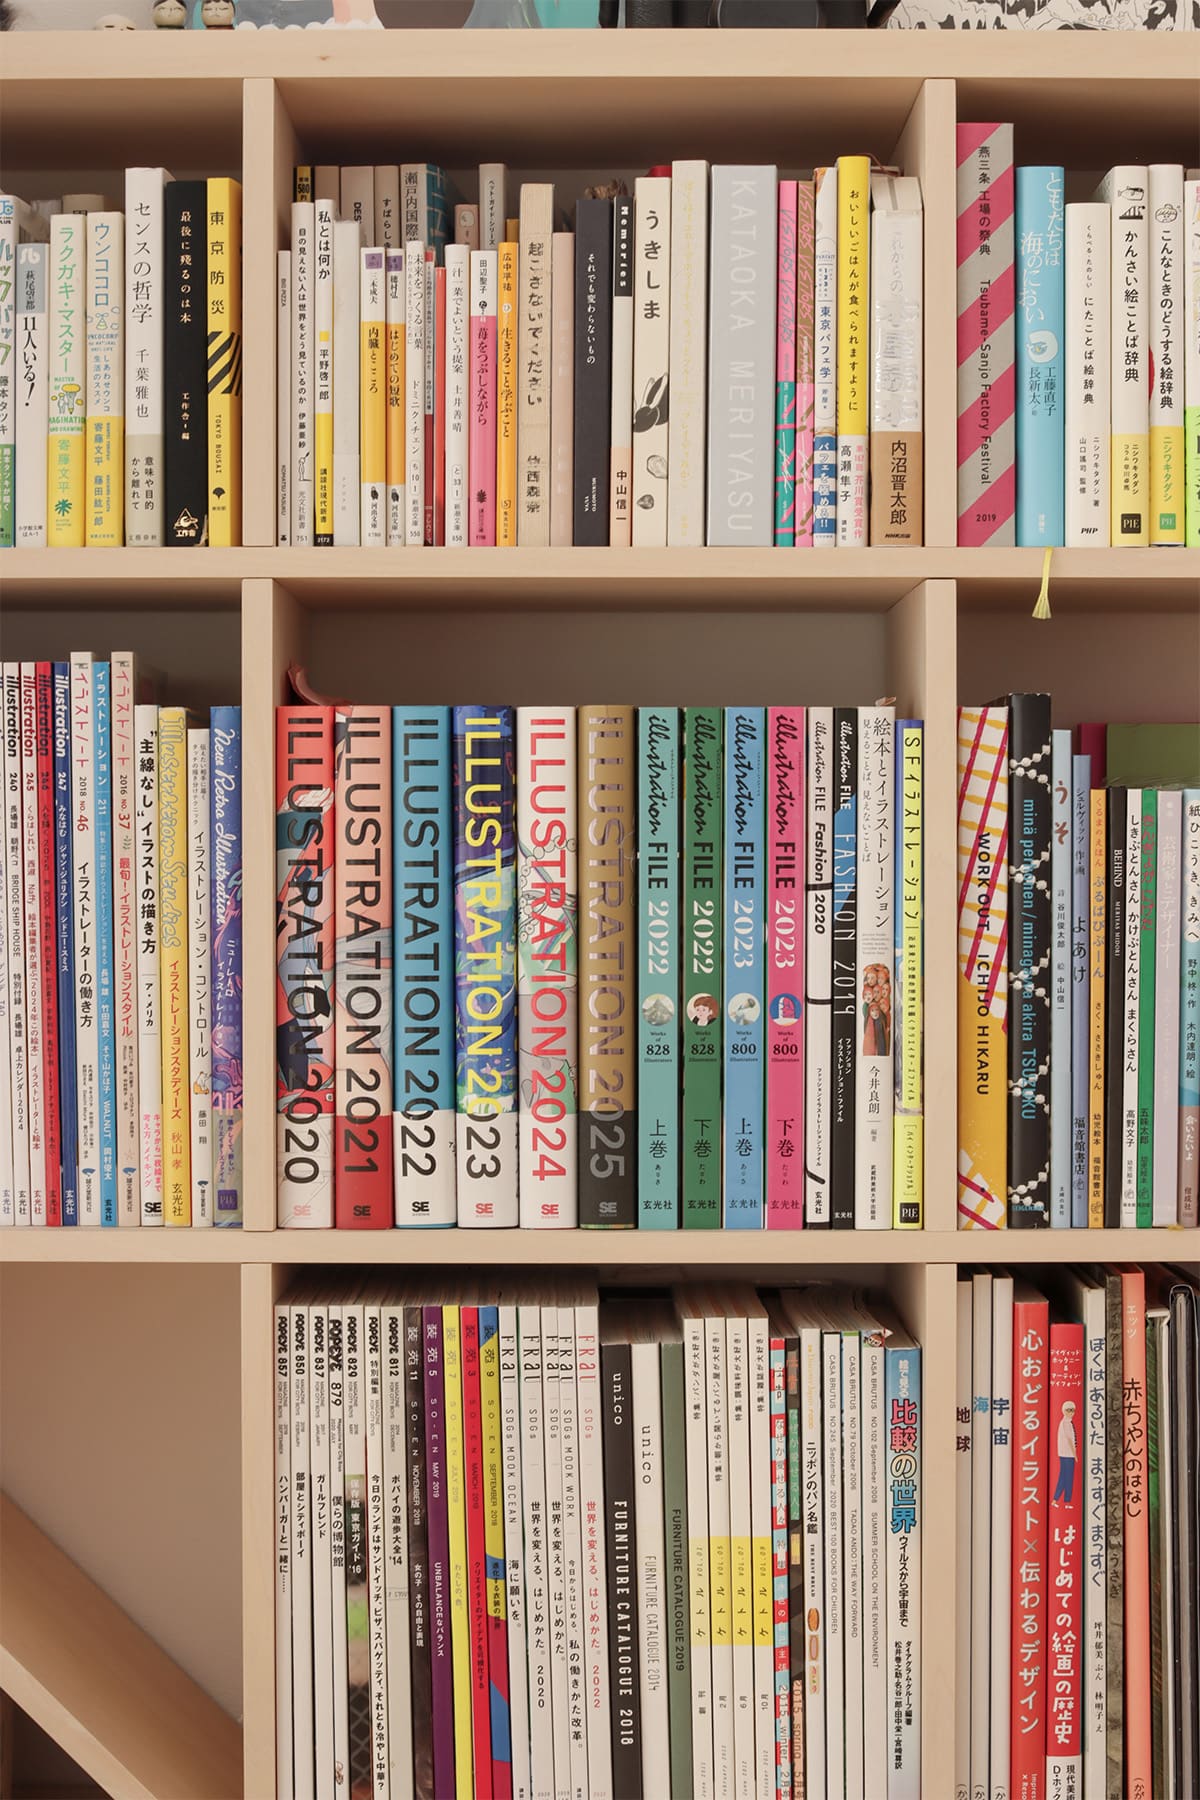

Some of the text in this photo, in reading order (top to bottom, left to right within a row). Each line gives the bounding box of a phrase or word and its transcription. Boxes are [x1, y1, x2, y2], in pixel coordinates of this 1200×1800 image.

[978, 145, 991, 256] 燕三条 工場の祭典
[1045, 172, 1064, 266] ともだちは
[57, 226, 76, 373] ラクガキ・マスター
[94, 223, 111, 307] ウンココロ
[133, 202, 153, 324] センスの哲学
[180, 210, 192, 323] 最後に残るのは本
[210, 210, 225, 315] 東京防災
[318, 210, 331, 401] 私とは何か 平野啓一郎
[413, 254, 425, 351] 未来をつくる言葉
[643, 210, 662, 320] うきしま
[848, 190, 860, 411] おいしいごはんが食べられますように
[1019, 232, 1045, 324] 海のにおい
[1124, 230, 1139, 382] かんさい絵ことば辞典
[298, 228, 307, 404] 目の見えない人は世界をどう見ているのか
[368, 326, 380, 394] 内臓とこころ
[389, 330, 400, 407] はじめての短歌
[452, 260, 464, 433] 一汁一菜でよいという提案 土井善晴
[477, 260, 489, 426] 田辺聖子 苺をつぶしながら
[527, 242, 544, 406] 起こさないでください
[727, 180, 758, 531] KATAOKA MERIYASU
[819, 306, 831, 378] 東京パフェ学
[1083, 297, 1095, 404] にたことば絵辞典
[1160, 229, 1174, 409] こんなときのどうする絵辞典
[136, 349, 150, 418] 千葉雅也
[500, 328, 513, 438] 生きること学ぶこと
[978, 279, 992, 484] Tsubame-Sanjo Factory Festival
[1044, 366, 1057, 417] 工藤直子
[144, 456, 155, 511] 意味や目的
[615, 470, 628, 521] 中山信一
[840, 445, 852, 502] 高瀬隼子
[890, 440, 908, 526] 内沼晋太郎
[976, 514, 997, 522] 2019
[1092, 437, 1100, 495] ニシワキタダシ
[1081, 527, 1098, 535] PHP
[1123, 517, 1140, 529] PIE
[6, 675, 20, 758] illustration
[22, 675, 36, 758] illustration
[38, 674, 51, 757] illustration
[55, 674, 69, 758] illustration
[96, 670, 108, 786] イラストレーション
[160, 716, 187, 949] Illustration Studies
[214, 728, 238, 925] New Retro Illustration
[647, 713, 670, 975] illustration FILE 2022
[693, 713, 717, 975] illustration FILE 2022
[734, 713, 757, 969] illustration FILE 2023
[775, 713, 798, 969] illustration FILE 2023
[814, 720, 827, 935] illustration FILE Fashion 2020
[874, 717, 892, 929] 絵本とイラストレーション
[904, 736, 921, 920] SFイラストレーション
[1023, 798, 1037, 835] minä
[1054, 780, 1070, 845] うそ
[833, 720, 857, 1016] illustration FILE FASHION 2019
[1020, 839, 1038, 908] perhonen
[1113, 849, 1123, 888] BEHIND
[77, 862, 93, 1028] イラストレーターの働き方
[284, 716, 324, 1184] ILLUSTRATION 2020
[344, 716, 382, 1173] ILLUSTRATION 2021
[401, 717, 440, 1177] ILLUSTRATION 2022
[464, 717, 503, 1179] ILLUSTRATION 2023
[530, 717, 568, 1182] ILLUSTRATION 2024
[588, 716, 626, 1178] ILLUSTRATION 2025
[976, 832, 991, 1095] WORK OUT ICHIJO HIKARU
[1072, 915, 1087, 984] よあけ
[1126, 815, 1140, 1073] しきぶとんさん かけぶとんさん まくらさん
[169, 960, 183, 1120] イラストレーションスタディーズ
[646, 1044, 671, 1055] 828
[690, 1044, 715, 1055] 828
[731, 1044, 757, 1055] 800
[772, 1044, 798, 1055] 800
[1022, 1004, 1037, 1041] akira
[649, 1117, 668, 1159] 上巻
[693, 1118, 712, 1159] 下巻
[867, 1065, 881, 1114] 今井良朗
[278, 1316, 288, 1378] POPEYE 857
[314, 1315, 325, 1378] POPEYE 837
[331, 1382, 342, 1407] 879
[347, 1316, 357, 1378] POPEYE 829
[388, 1316, 399, 1377] POPEYE 812
[956, 1406, 971, 1453] 地球
[973, 1396, 990, 1414] 海
[992, 1397, 1010, 1446] 宇宙
[1122, 1377, 1144, 1519] 赤ちゃんのはなし
[316, 1475, 327, 1539] ガールフレンド
[805, 1441, 820, 1535] ニッポンのパン名鑑
[890, 1398, 918, 1535] 比較の世界
[1089, 1337, 1106, 1588] ぼくは あるいた まっすぐ まっすぐ
[332, 1495, 344, 1568] 僕らの博物館
[612, 1373, 634, 1746] unico FURNITURE CATALOGUE 2018
[871, 1547, 879, 1581] SCHOOL
[1018, 1329, 1044, 1735] 心おどるイラスト×伝わるデザイン
[434, 1562, 445, 1658] UNBALANCEなバランス
[531, 1501, 546, 1709] 世界を変える、はじめかた。 2020
[586, 1500, 602, 1709] 世界を変える、はじめかた。 2022
[672, 1508, 685, 1672] FURNITURE CATALOGUE 2019
[1051, 1525, 1078, 1745] はじめての絵画の歴史
